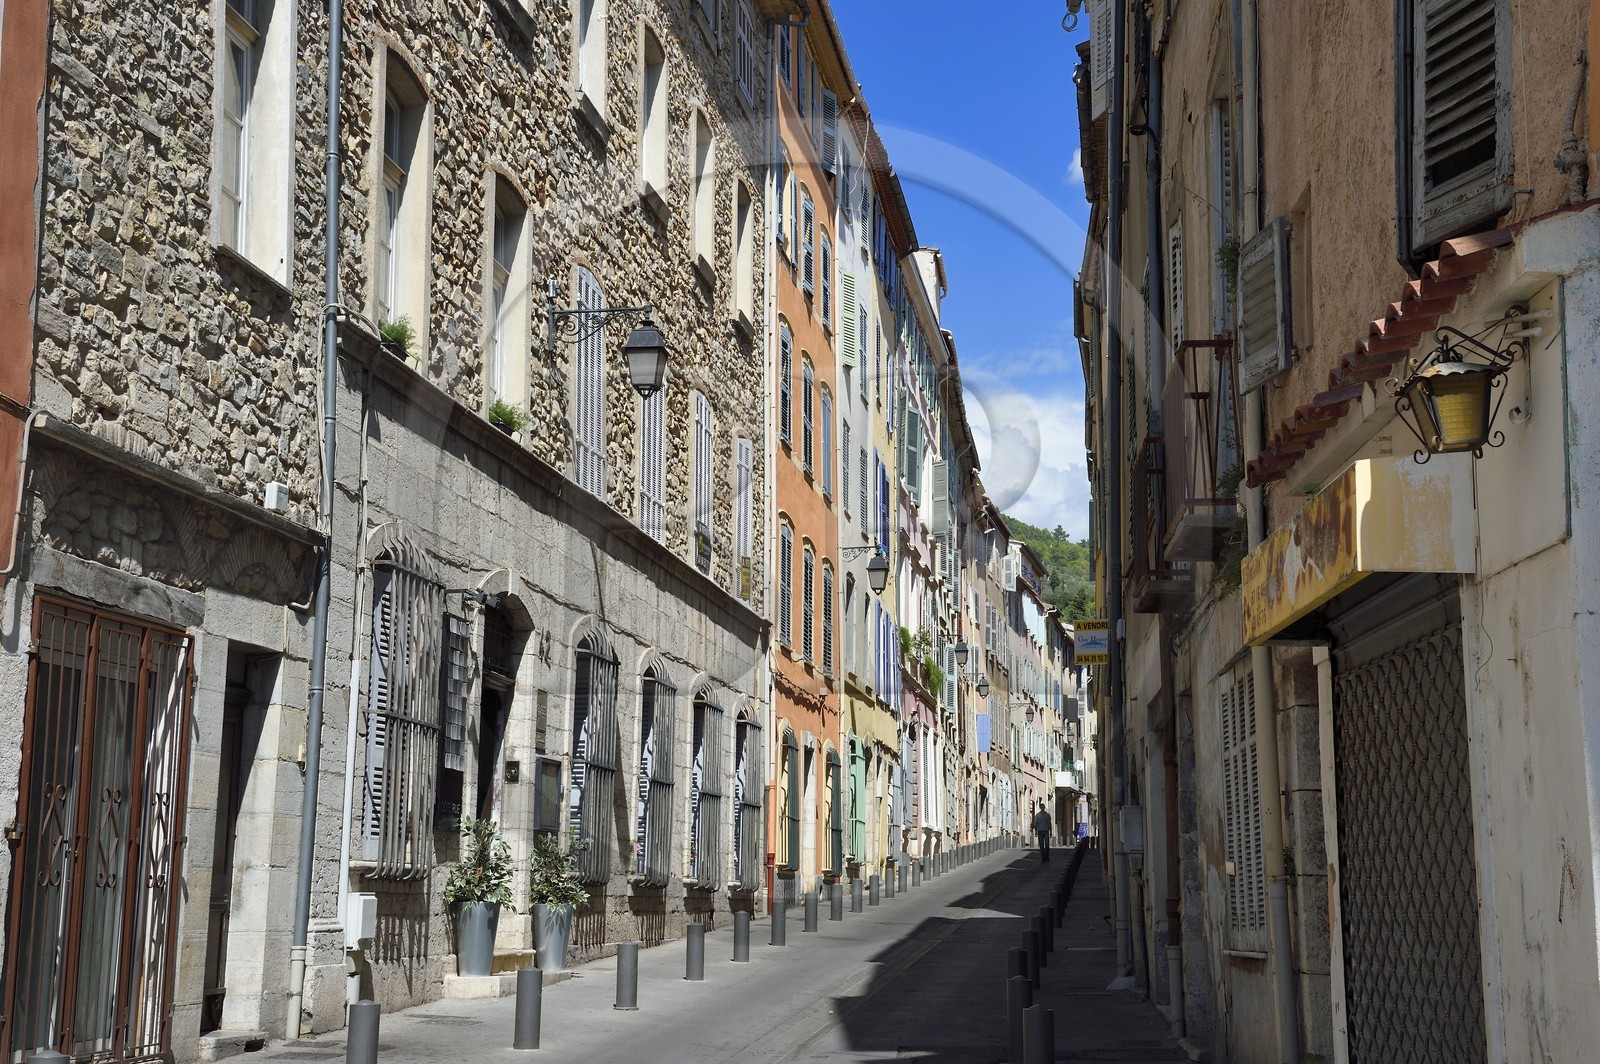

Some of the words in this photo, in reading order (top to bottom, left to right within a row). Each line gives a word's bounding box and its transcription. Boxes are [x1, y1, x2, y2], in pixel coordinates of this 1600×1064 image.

[1083, 622, 1108, 630] VENDRE
[1077, 655, 1083, 663] 04
[452, 803, 460, 814] RUE
